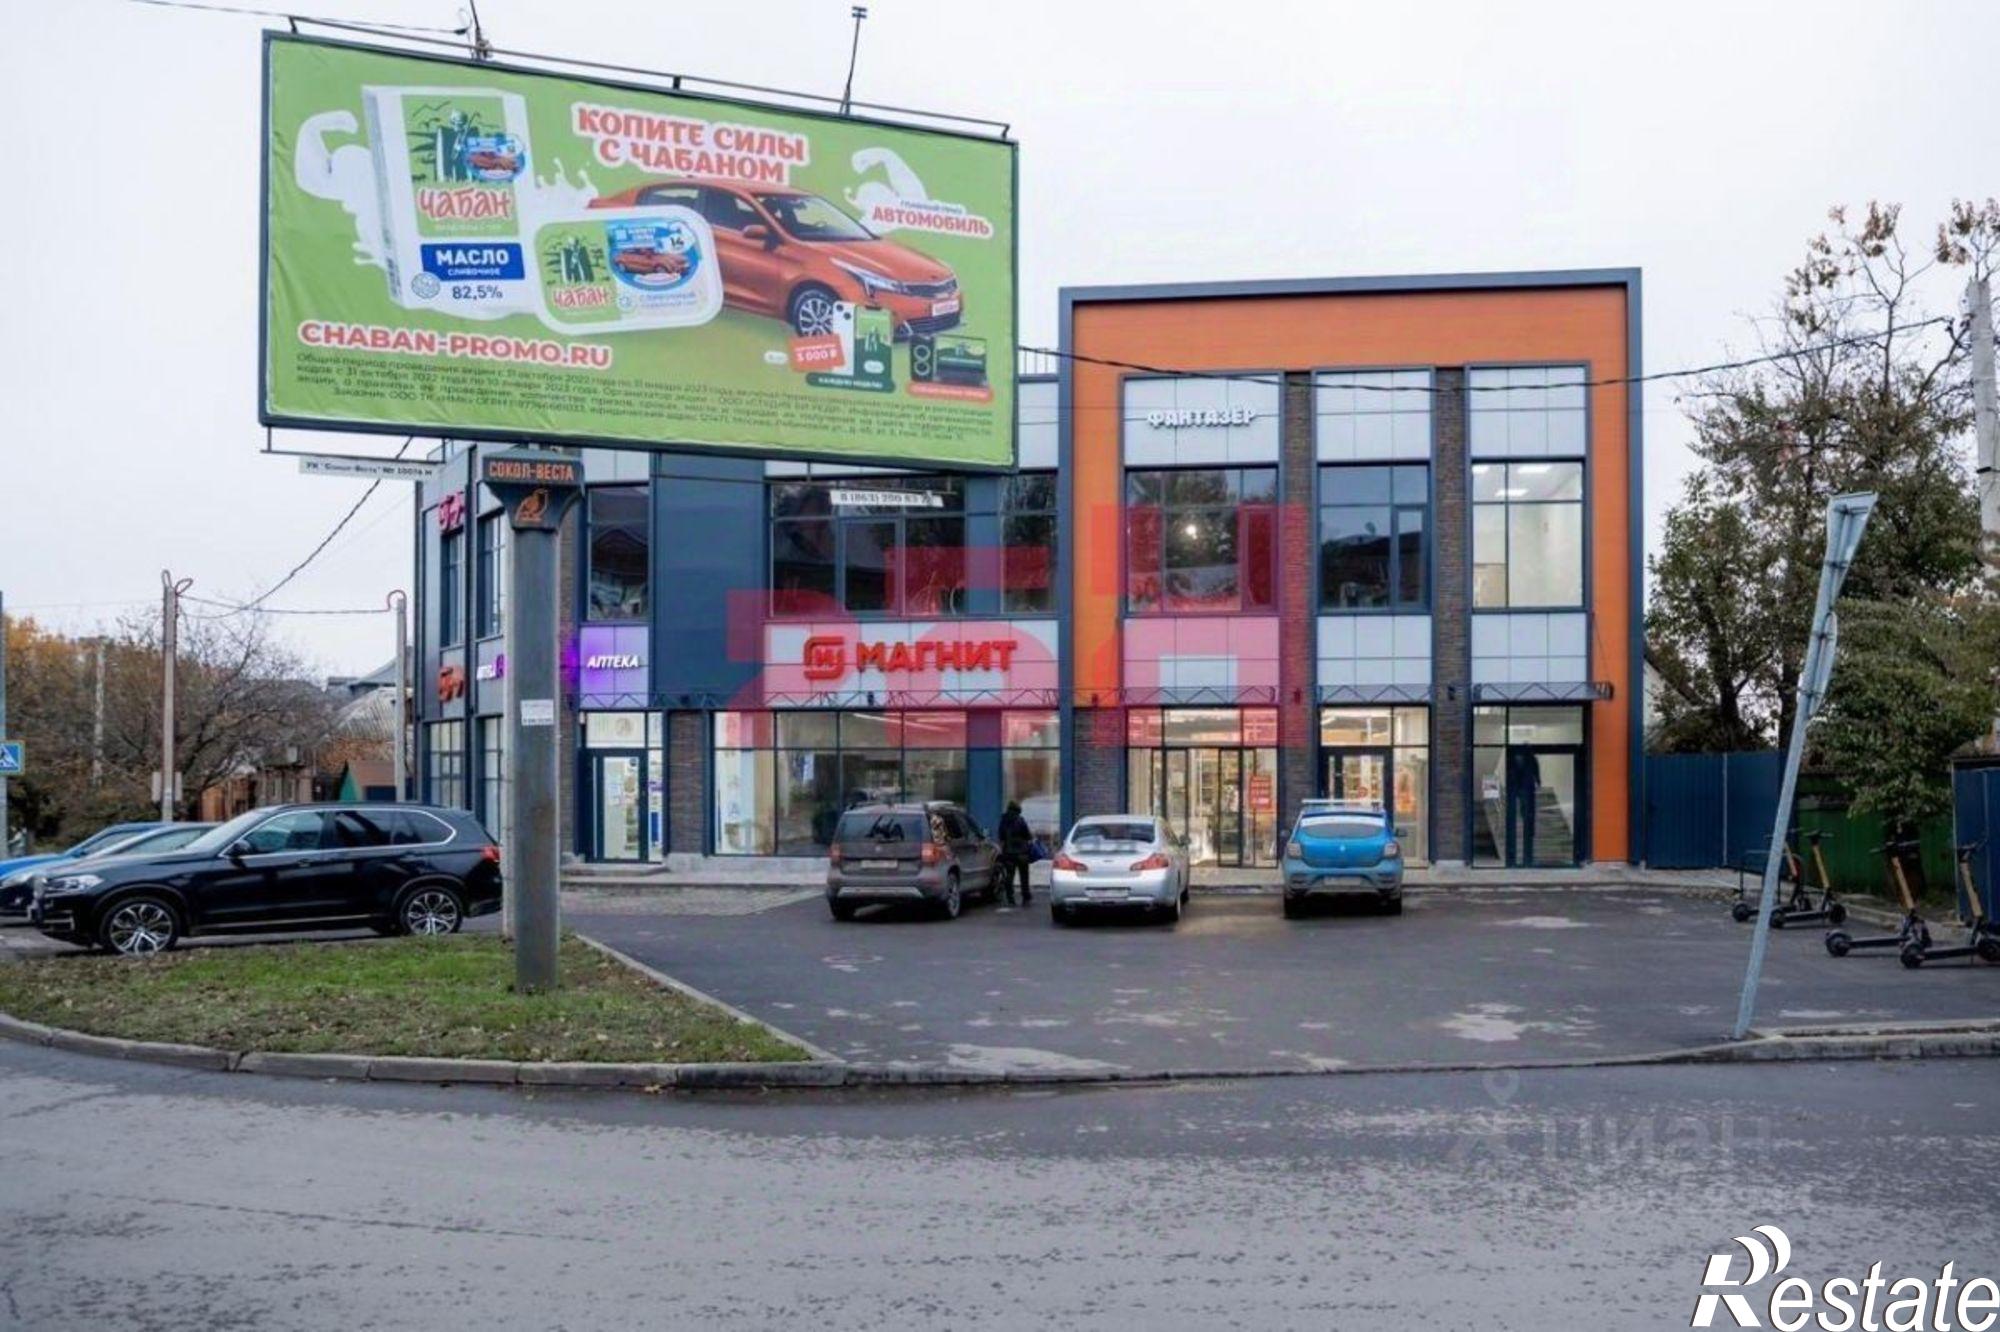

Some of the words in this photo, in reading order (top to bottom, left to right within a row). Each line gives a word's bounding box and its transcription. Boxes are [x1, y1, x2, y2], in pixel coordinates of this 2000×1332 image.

[578, 107, 704, 145] КОПИТЕ
[713, 125, 805, 163] СИЛЫ
[599, 141, 621, 162] С
[630, 144, 784, 183] ЧАБАНОМ
[872, 205, 990, 236] АВТОМОБИЛЬ
[435, 249, 509, 267] МАСЛО
[452, 284, 504, 301] 82,5%
[300, 322, 611, 367] CHABAN-PROMO.RU
[488, 461, 575, 481] СОКОЛ-ВЕСТА
[587, 655, 640, 669] АПТЕКА
[855, 639, 1018, 673] МАГНИТ
